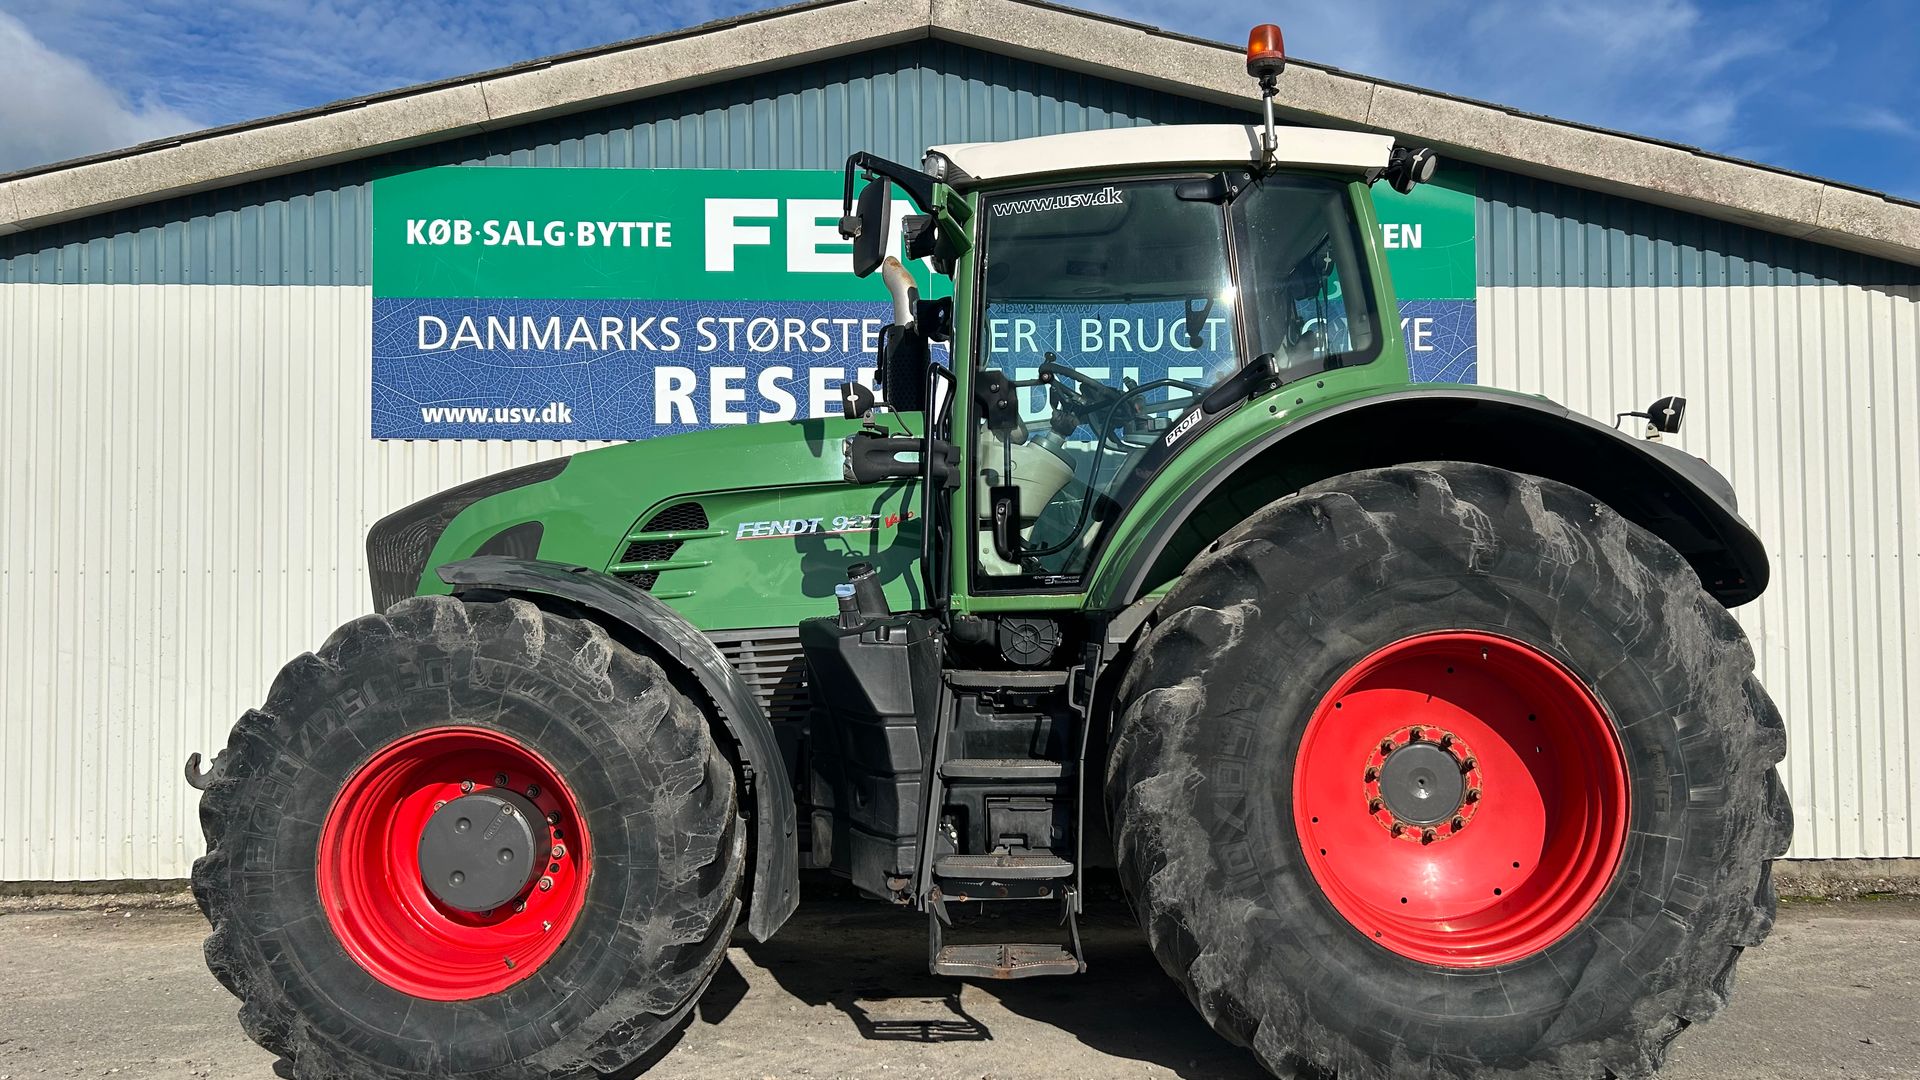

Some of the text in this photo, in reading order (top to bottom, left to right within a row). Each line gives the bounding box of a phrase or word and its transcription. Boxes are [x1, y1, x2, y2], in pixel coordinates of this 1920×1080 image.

[993, 186, 1123, 217] www.usv.dk
[417, 315, 681, 351] DANMARKS
[696, 317, 882, 352] STØRSTE
[420, 401, 573, 424] www.usv.dk
[1167, 409, 1201, 444] PROFI
[737, 517, 824, 540] FENDT
